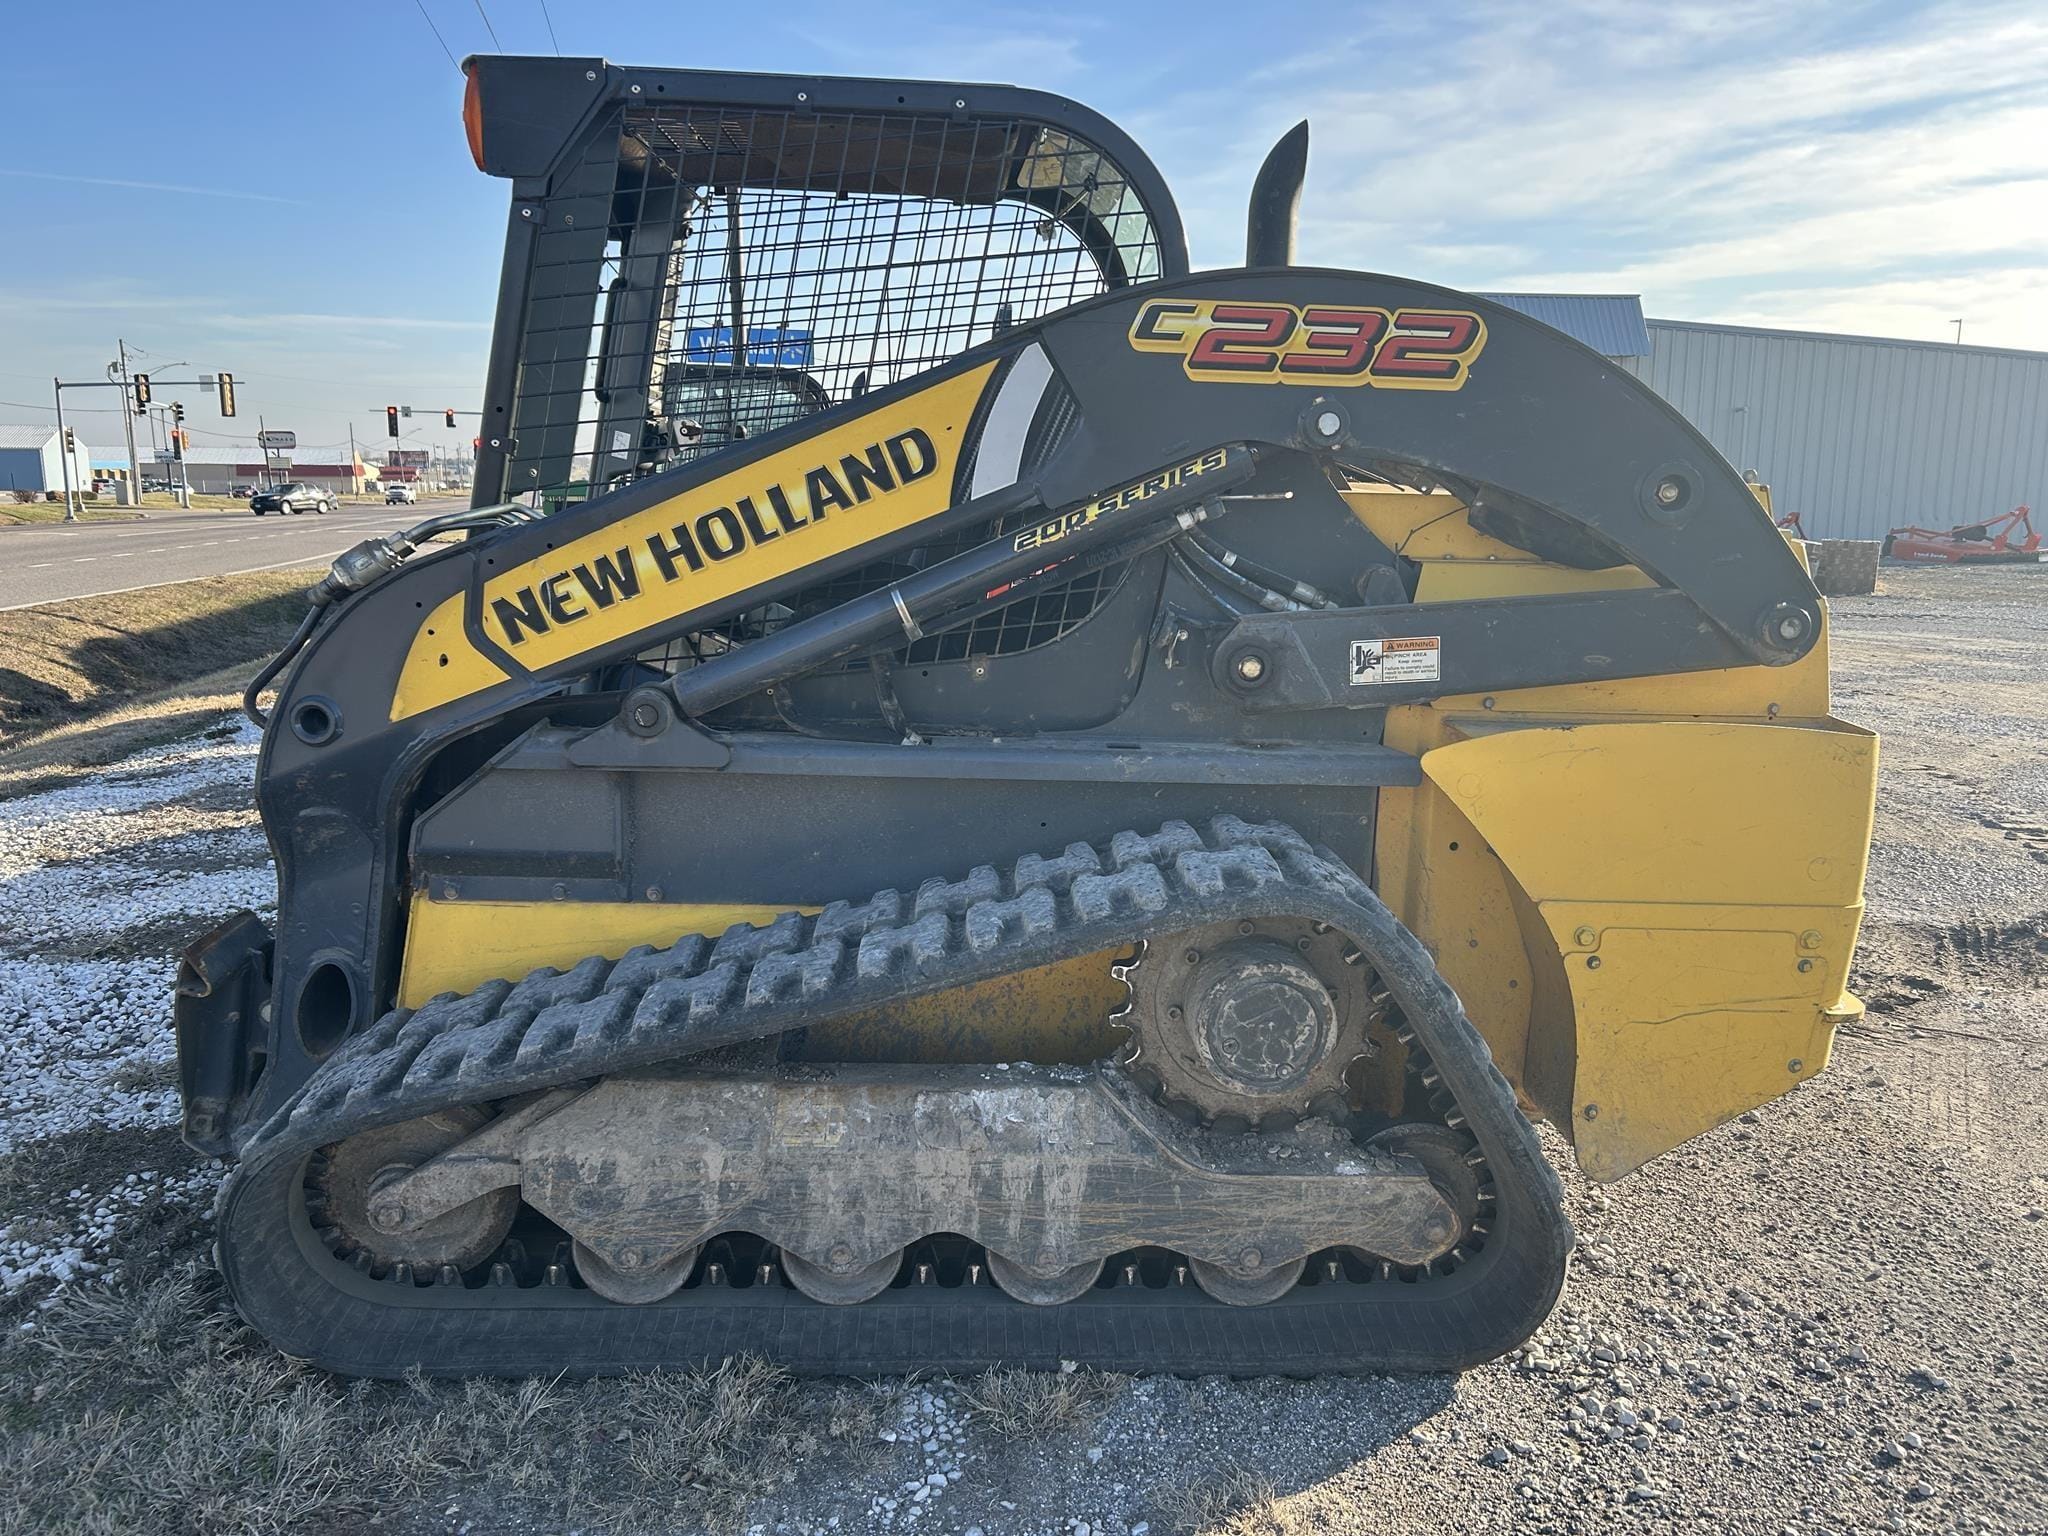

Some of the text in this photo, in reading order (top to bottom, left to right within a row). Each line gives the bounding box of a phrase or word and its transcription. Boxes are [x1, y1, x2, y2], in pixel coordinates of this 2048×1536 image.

[1129, 298, 1488, 391] C232
[1098, 448, 1227, 513] SERIES
[490, 545, 643, 646] NEW
[645, 427, 938, 583] HOLLAND
[1396, 641, 1434, 649] WARNING
